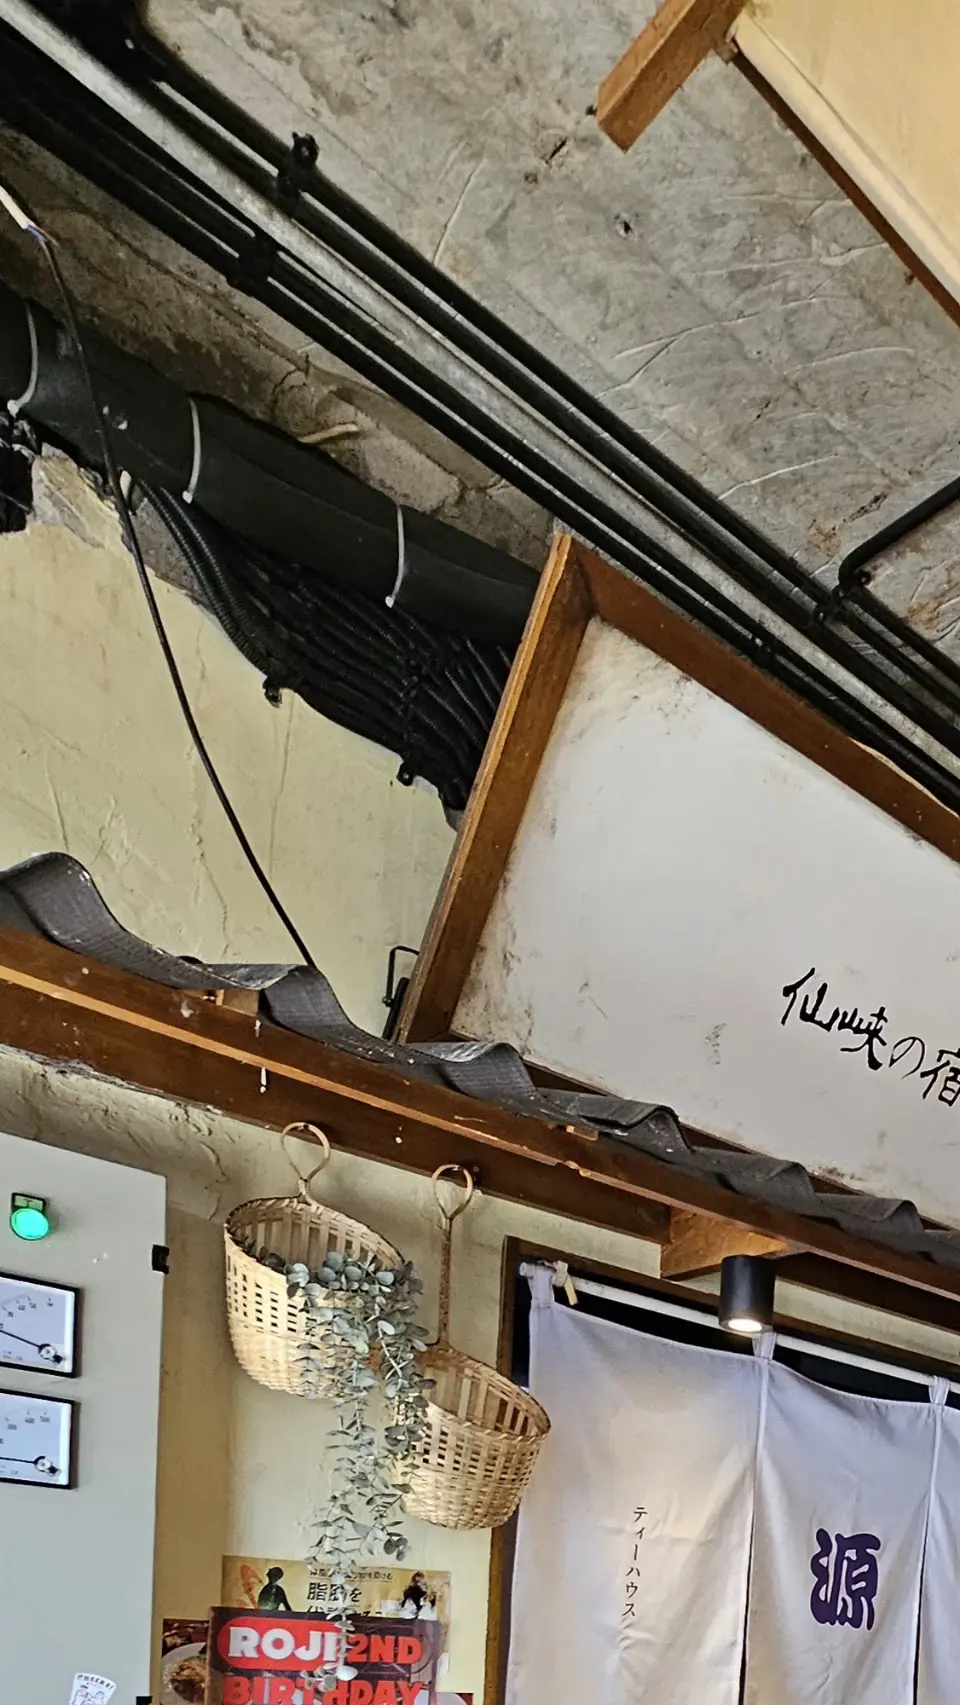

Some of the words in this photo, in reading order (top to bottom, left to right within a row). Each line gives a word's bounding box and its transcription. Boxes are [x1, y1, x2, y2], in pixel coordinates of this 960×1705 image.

[621, 1506, 648, 1617] ティーハウス
[347, 1634, 425, 1665] 2ND
